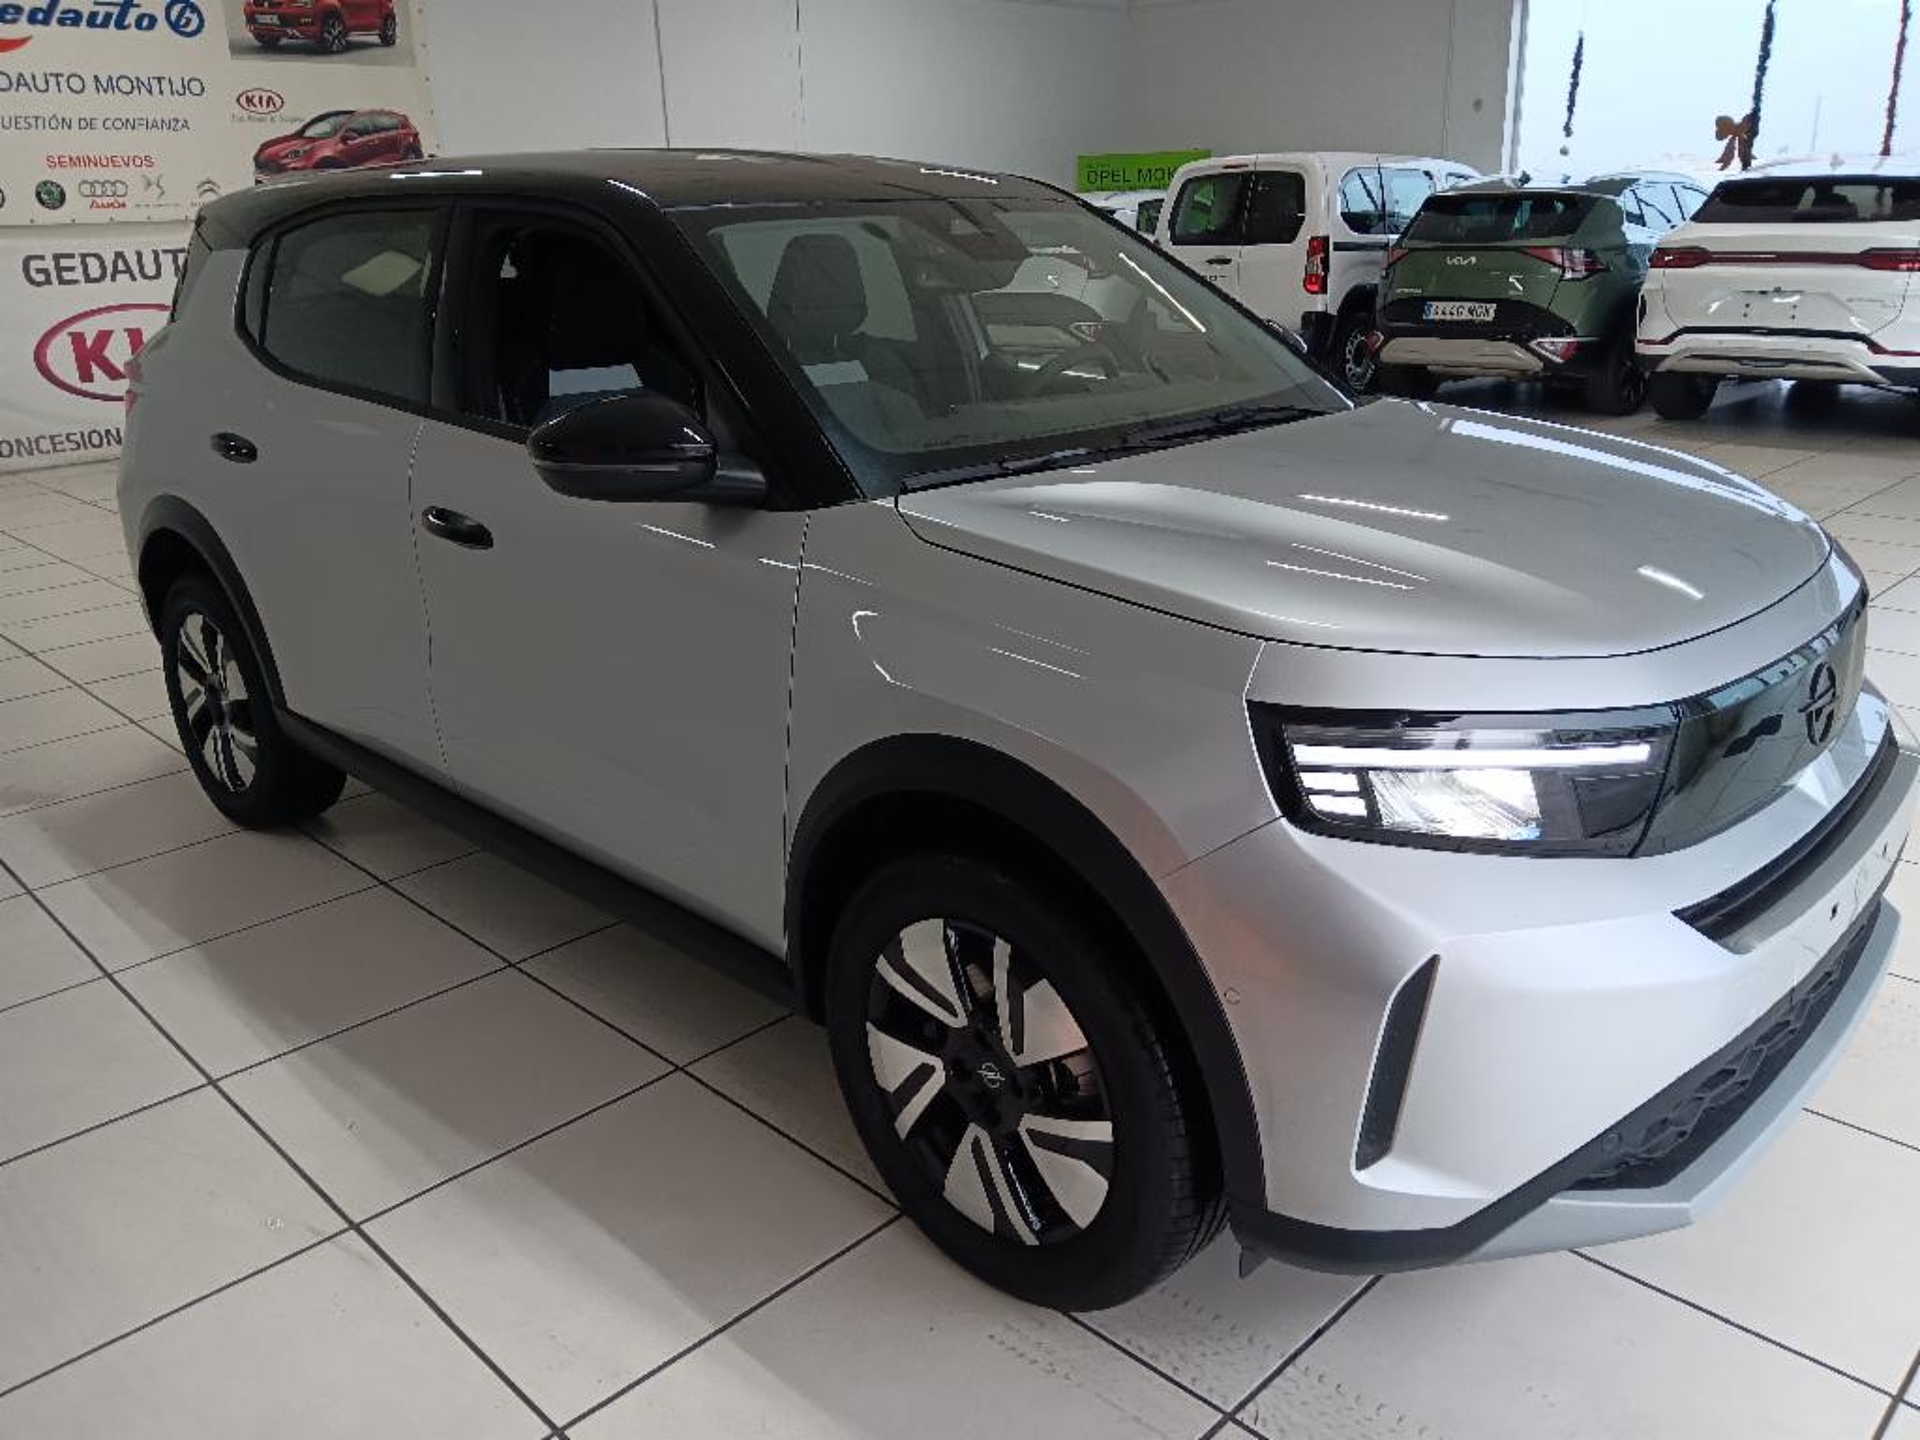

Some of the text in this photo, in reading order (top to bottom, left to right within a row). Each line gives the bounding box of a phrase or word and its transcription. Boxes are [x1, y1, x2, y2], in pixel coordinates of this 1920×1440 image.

[94, 74, 205, 97] MONTIJO
[245, 94, 276, 108] KIA
[1, 114, 190, 132] UESTIÓN DE CONFIANZA
[46, 155, 155, 169] SEMINUEVOS
[1086, 168, 1131, 184] OPEL
